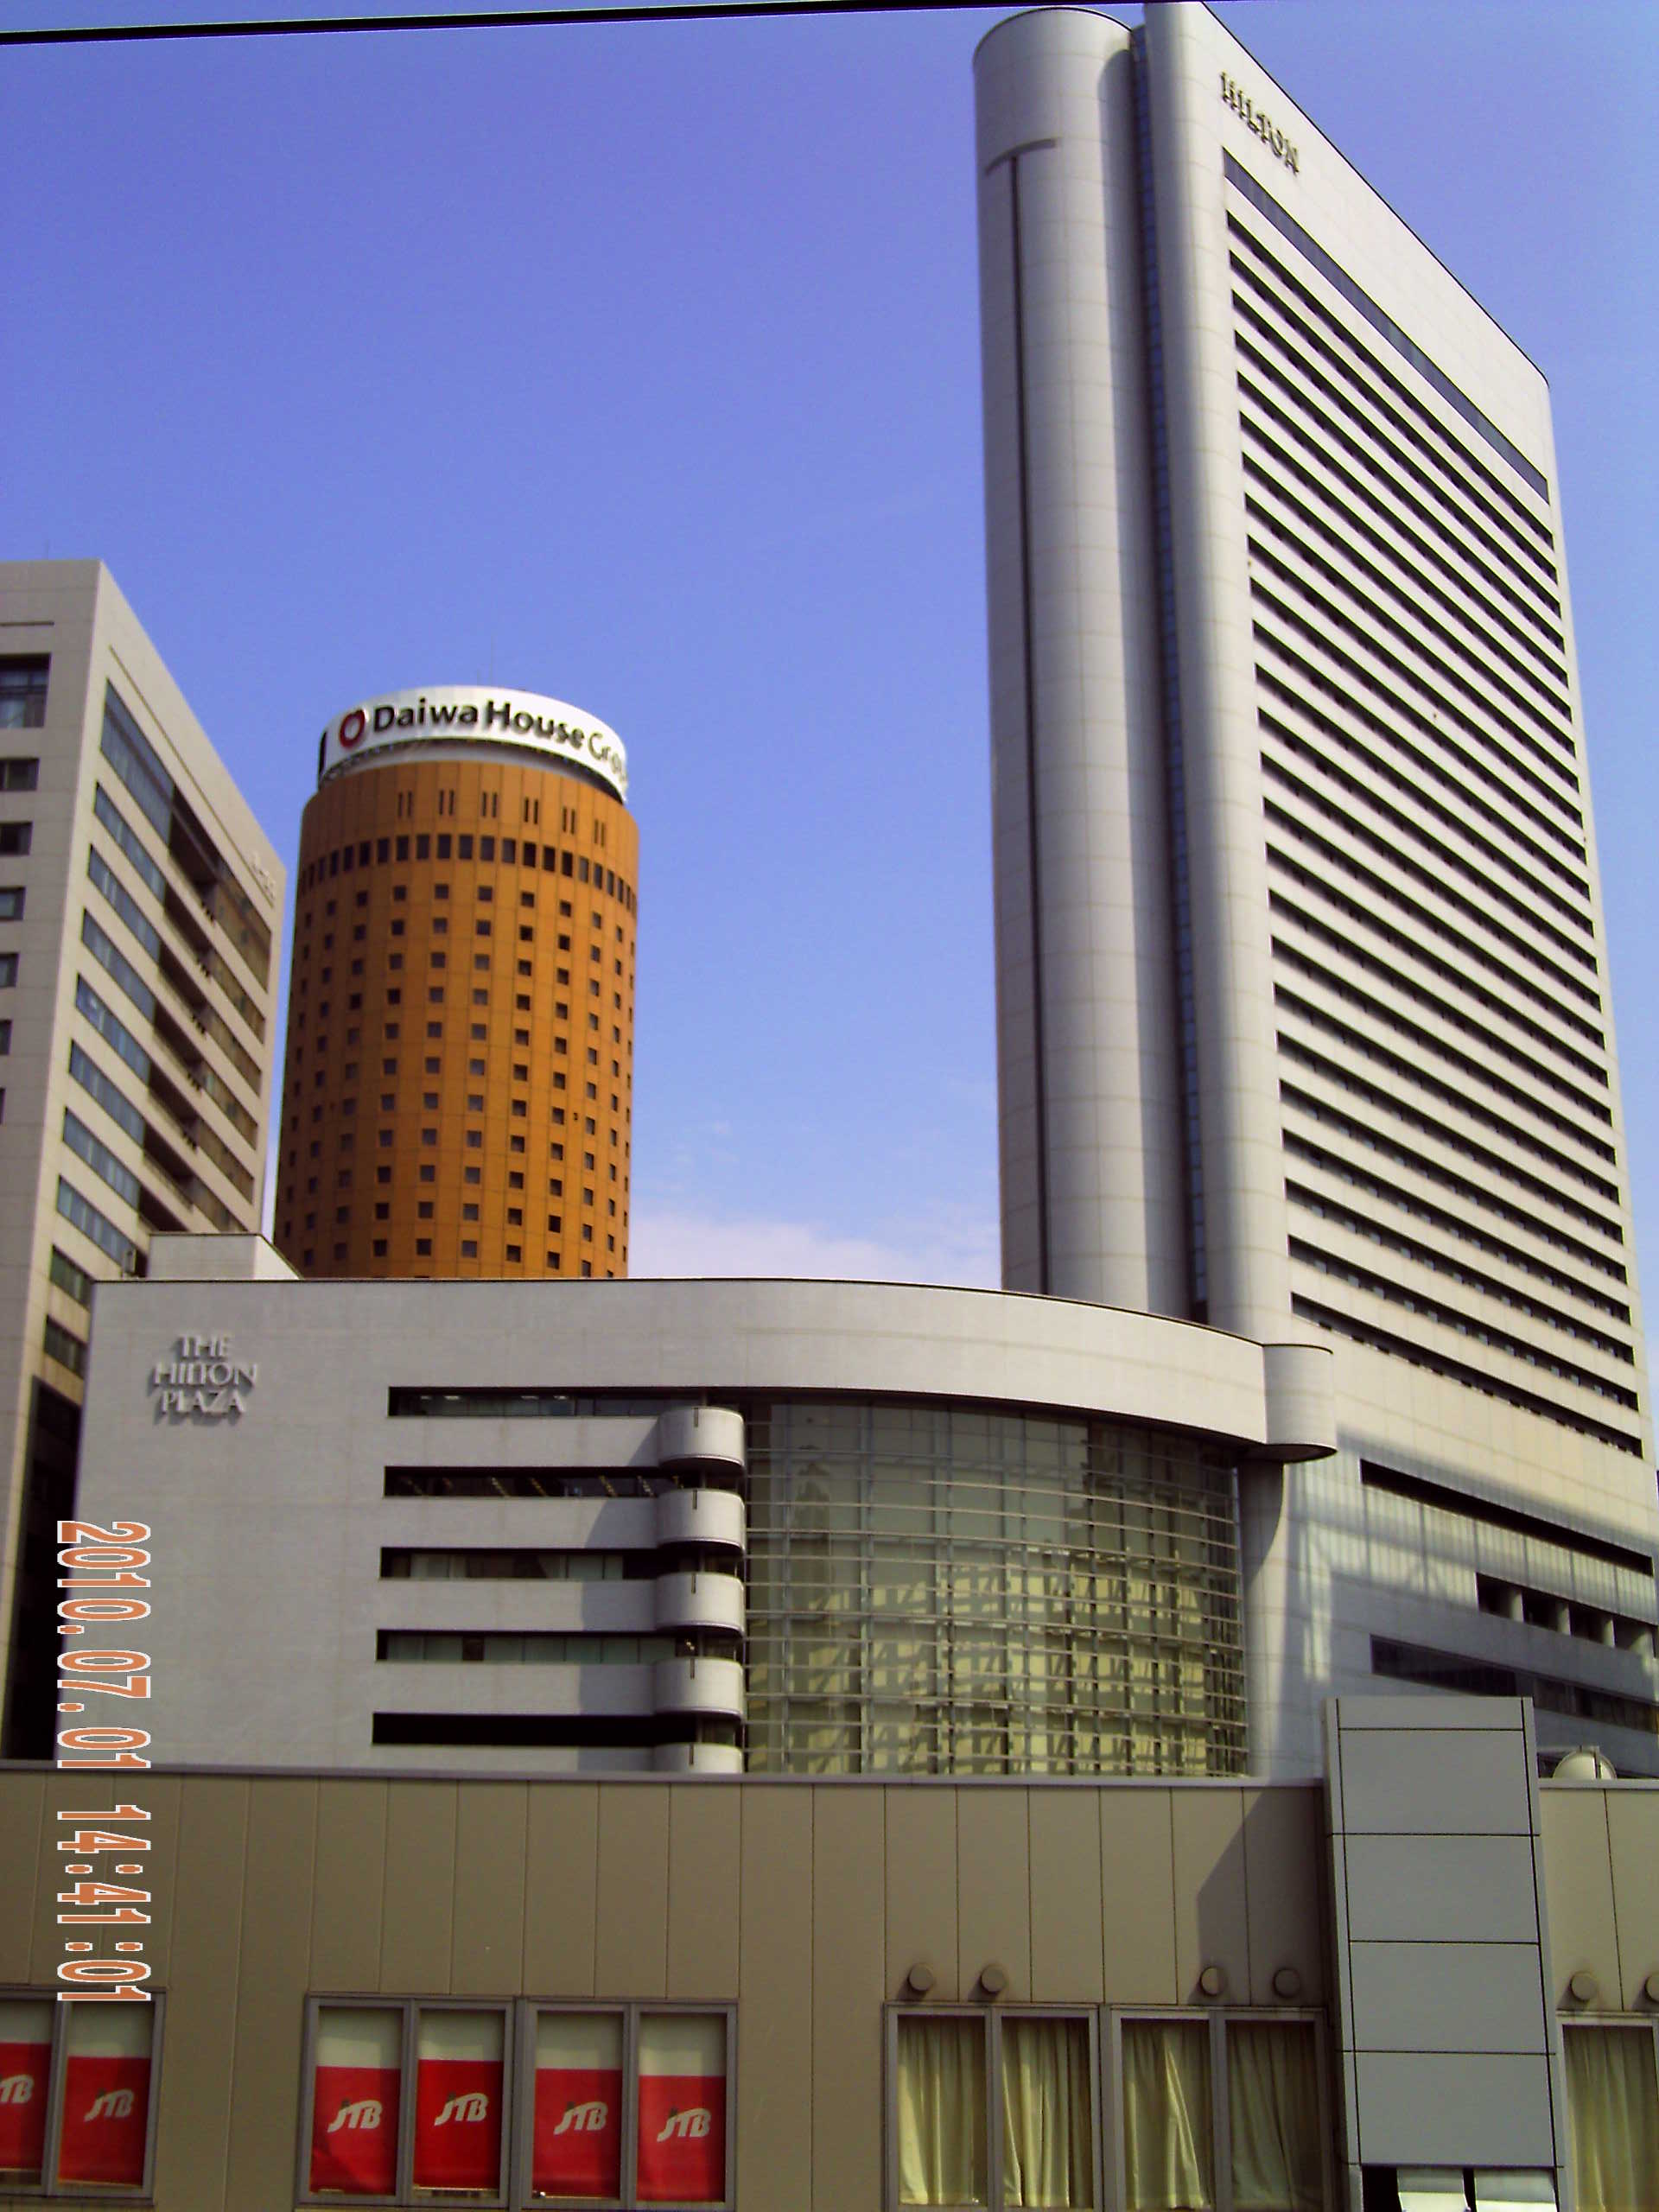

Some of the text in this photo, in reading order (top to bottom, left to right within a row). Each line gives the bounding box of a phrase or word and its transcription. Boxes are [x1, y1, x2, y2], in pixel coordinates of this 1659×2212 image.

[1219, 71, 1300, 176] HILTON
[374, 697, 478, 734] Daiwa
[486, 699, 586, 749] House
[177, 1335, 229, 1361] THE
[151, 1361, 257, 1389] HILTON
[159, 1388, 246, 1417] PLAZA
[0, 2074, 35, 2104] TB
[84, 2088, 135, 2122] JTB
[327, 2099, 383, 2133] JTB
[435, 2092, 489, 2126] JTB
[553, 2101, 608, 2136] JTB
[656, 2107, 712, 2143] JTB
